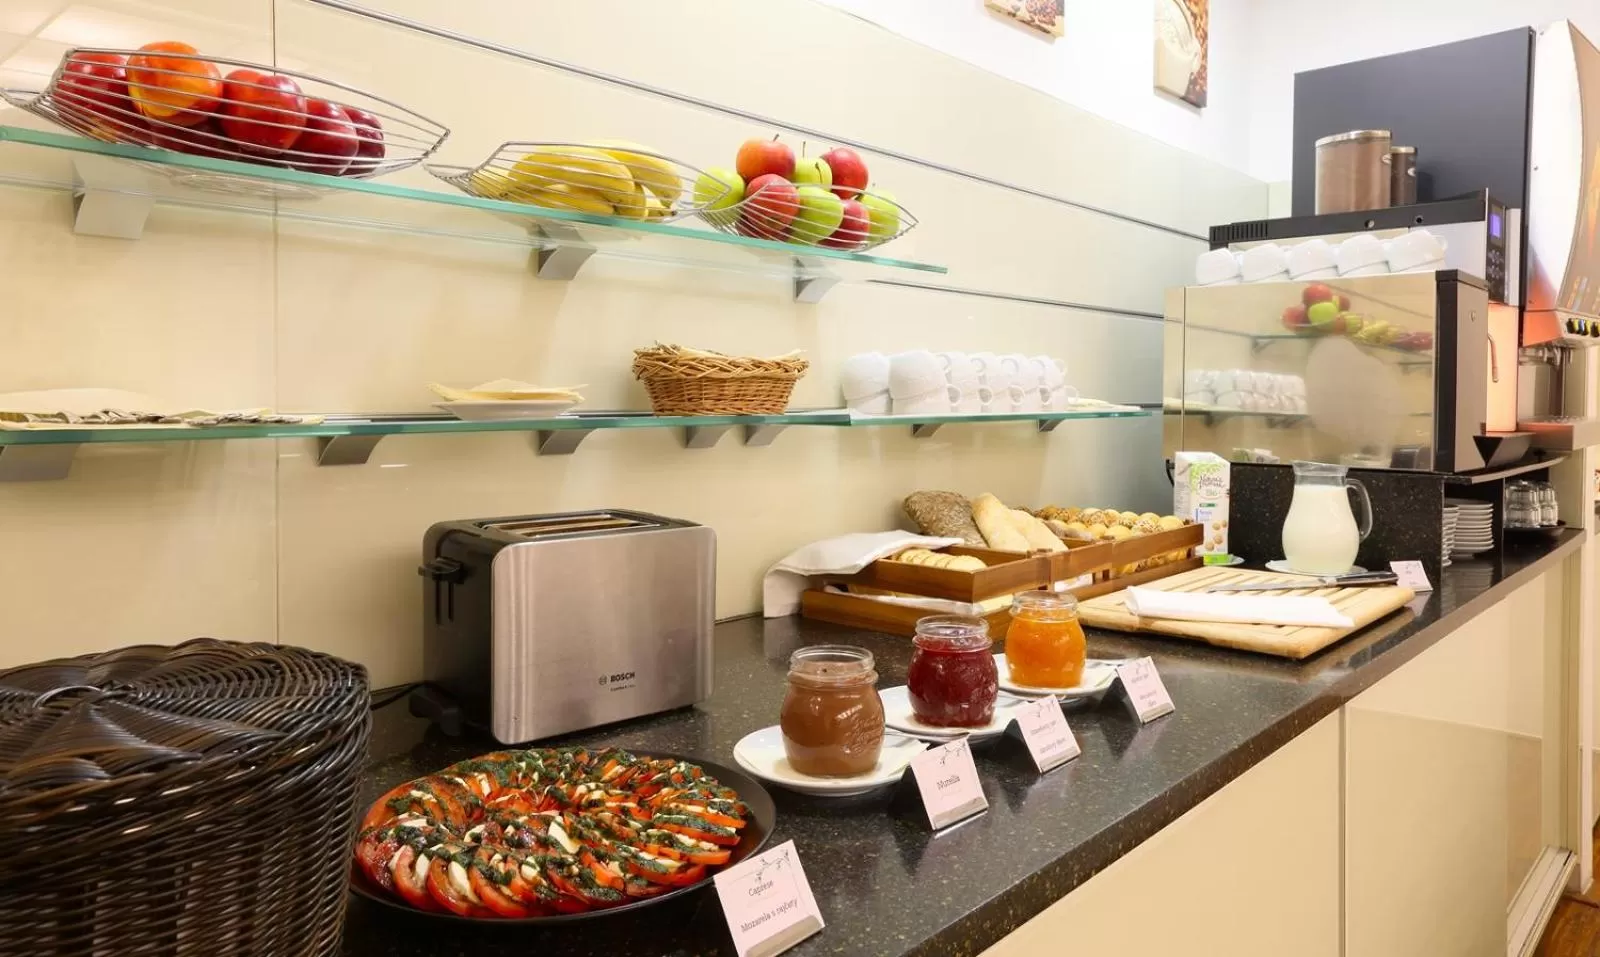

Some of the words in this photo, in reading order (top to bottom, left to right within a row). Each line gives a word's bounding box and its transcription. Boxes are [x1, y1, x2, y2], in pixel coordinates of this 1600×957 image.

[611, 671, 636, 682] BOSCH
[936, 775, 961, 790] Nutella
[748, 880, 774, 897] Caprese
